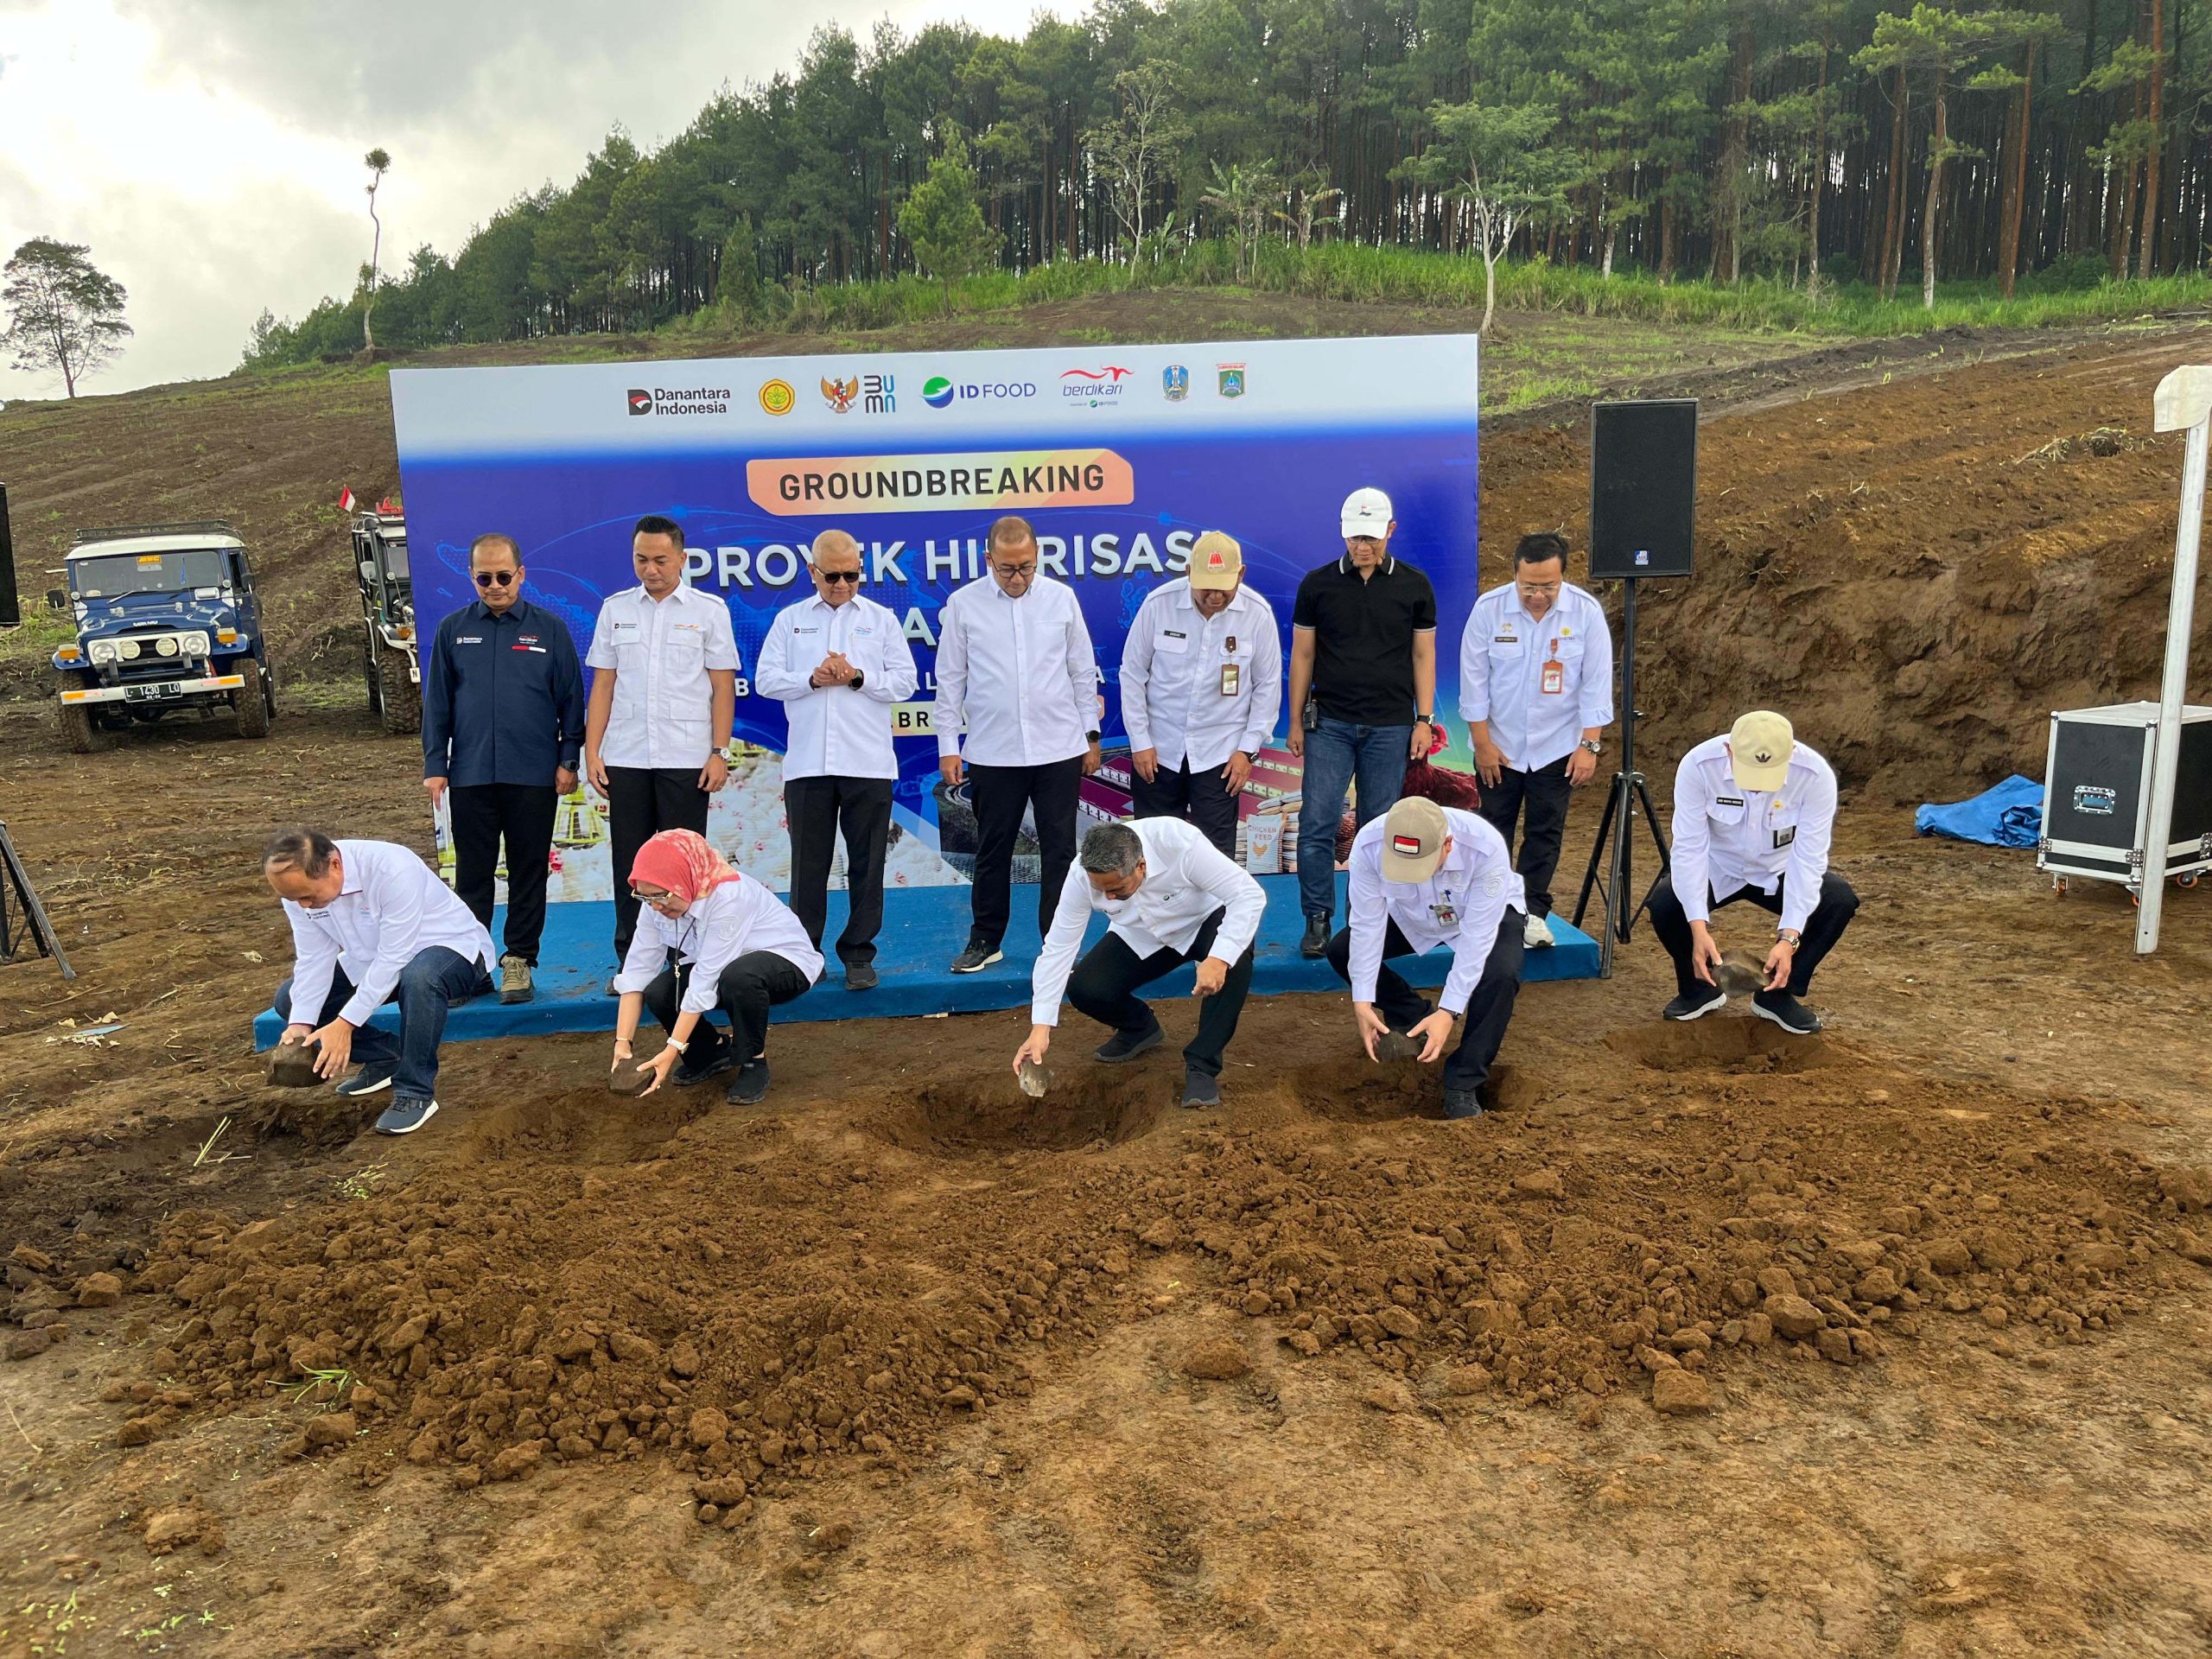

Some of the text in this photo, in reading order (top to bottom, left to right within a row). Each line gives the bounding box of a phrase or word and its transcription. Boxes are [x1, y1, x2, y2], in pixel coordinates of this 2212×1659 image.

[655, 388, 731, 402] Danantara
[1063, 384, 1122, 397] berdikari
[656, 401, 727, 415] Indonesia
[779, 463, 1104, 501] GROUNDBREAKING
[925, 531, 1220, 581] HIRISAS
[140, 684, 160, 696] 1430
[1247, 824, 1277, 834] CHICKEN
